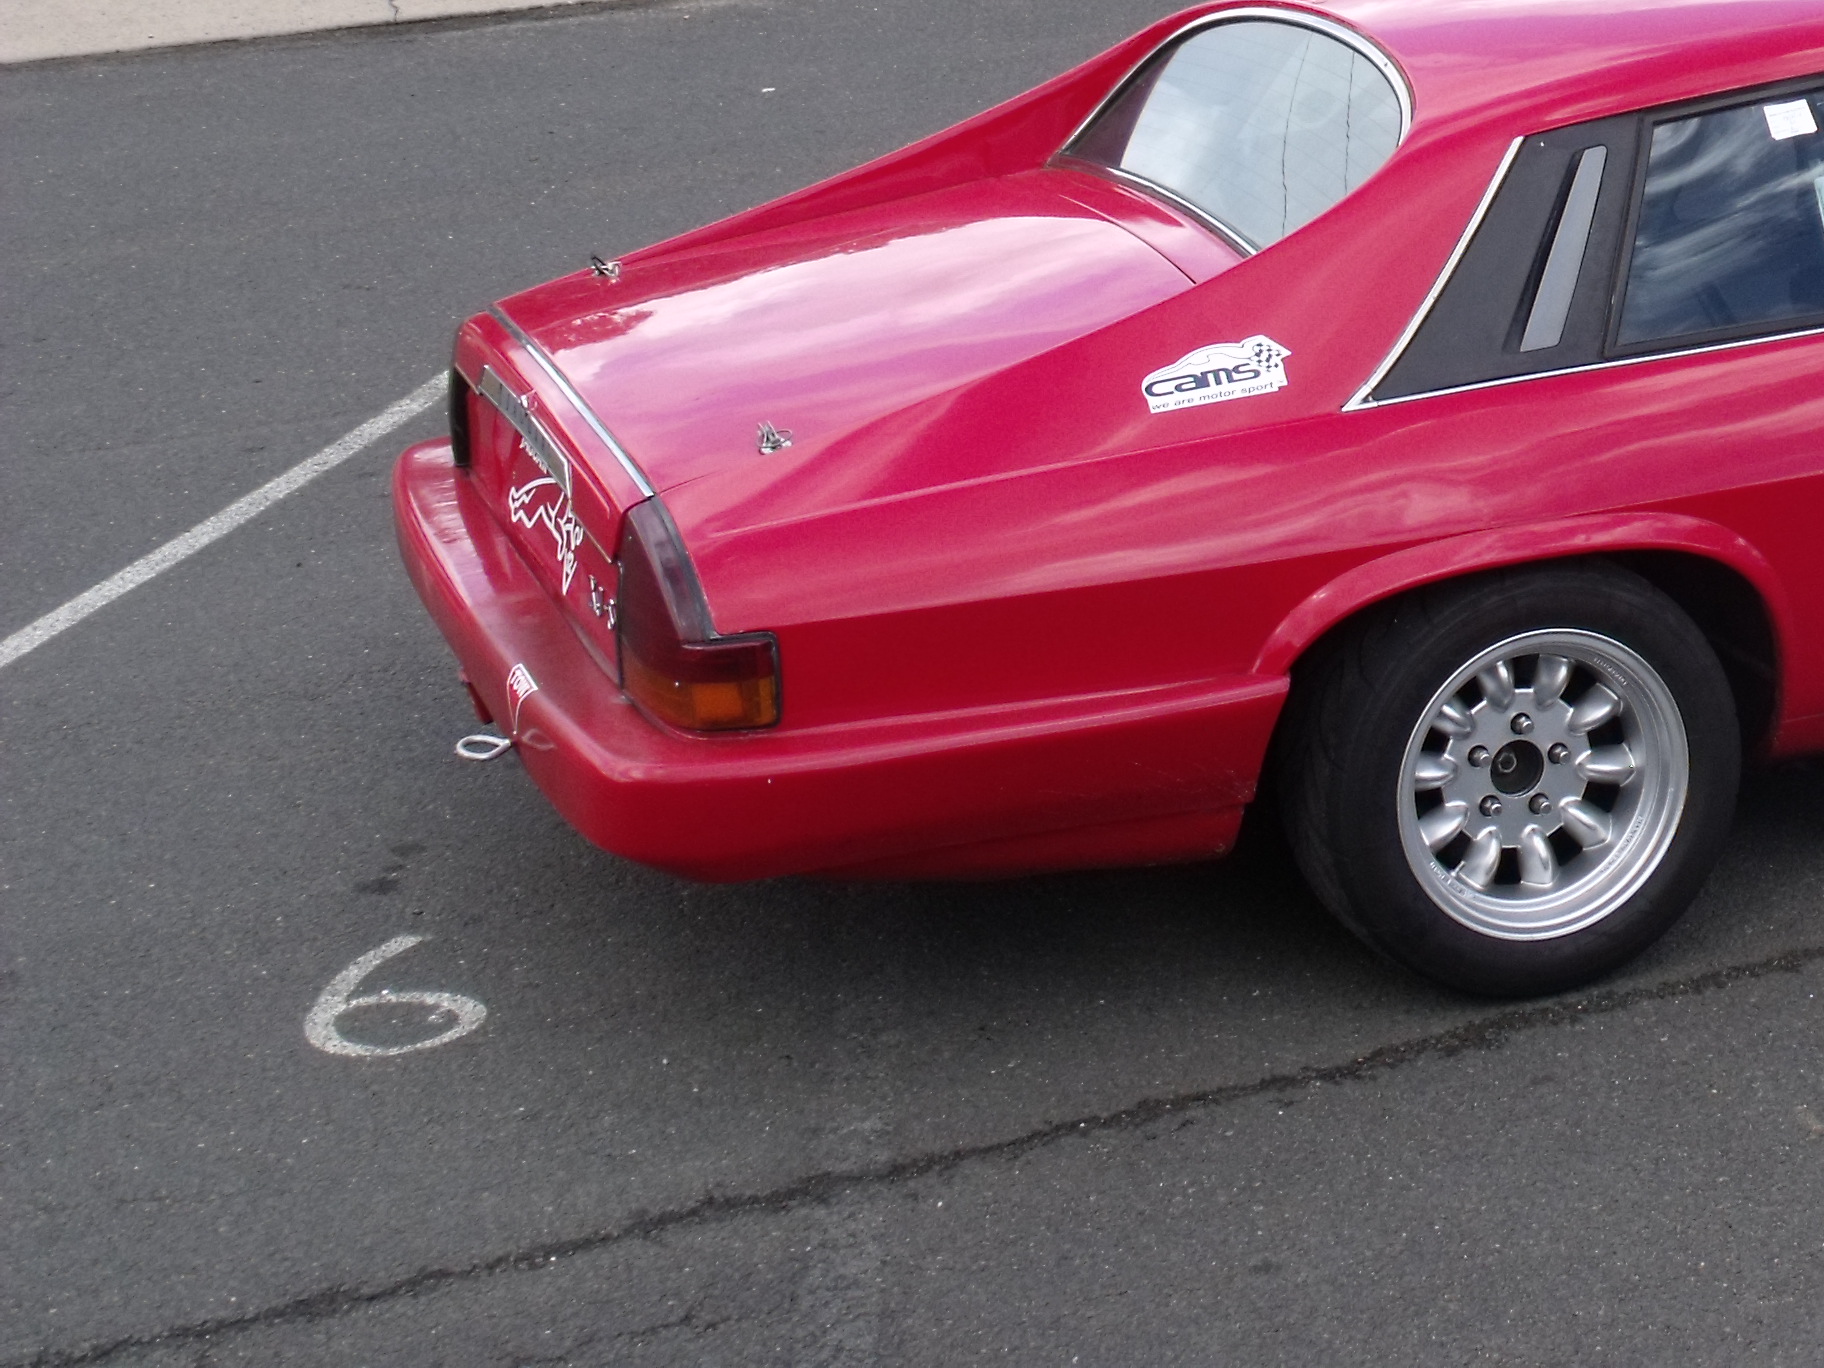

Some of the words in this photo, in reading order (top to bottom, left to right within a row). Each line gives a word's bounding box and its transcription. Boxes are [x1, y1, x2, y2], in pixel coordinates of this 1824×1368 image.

[1144, 363, 1261, 397] cams
[1151, 401, 1170, 411] we
[1174, 397, 1194, 407] are
[1198, 389, 1237, 402] motor
[1240, 381, 1274, 396] sport
[510, 669, 530, 698] TOW
[303, 934, 487, 1057] 6
